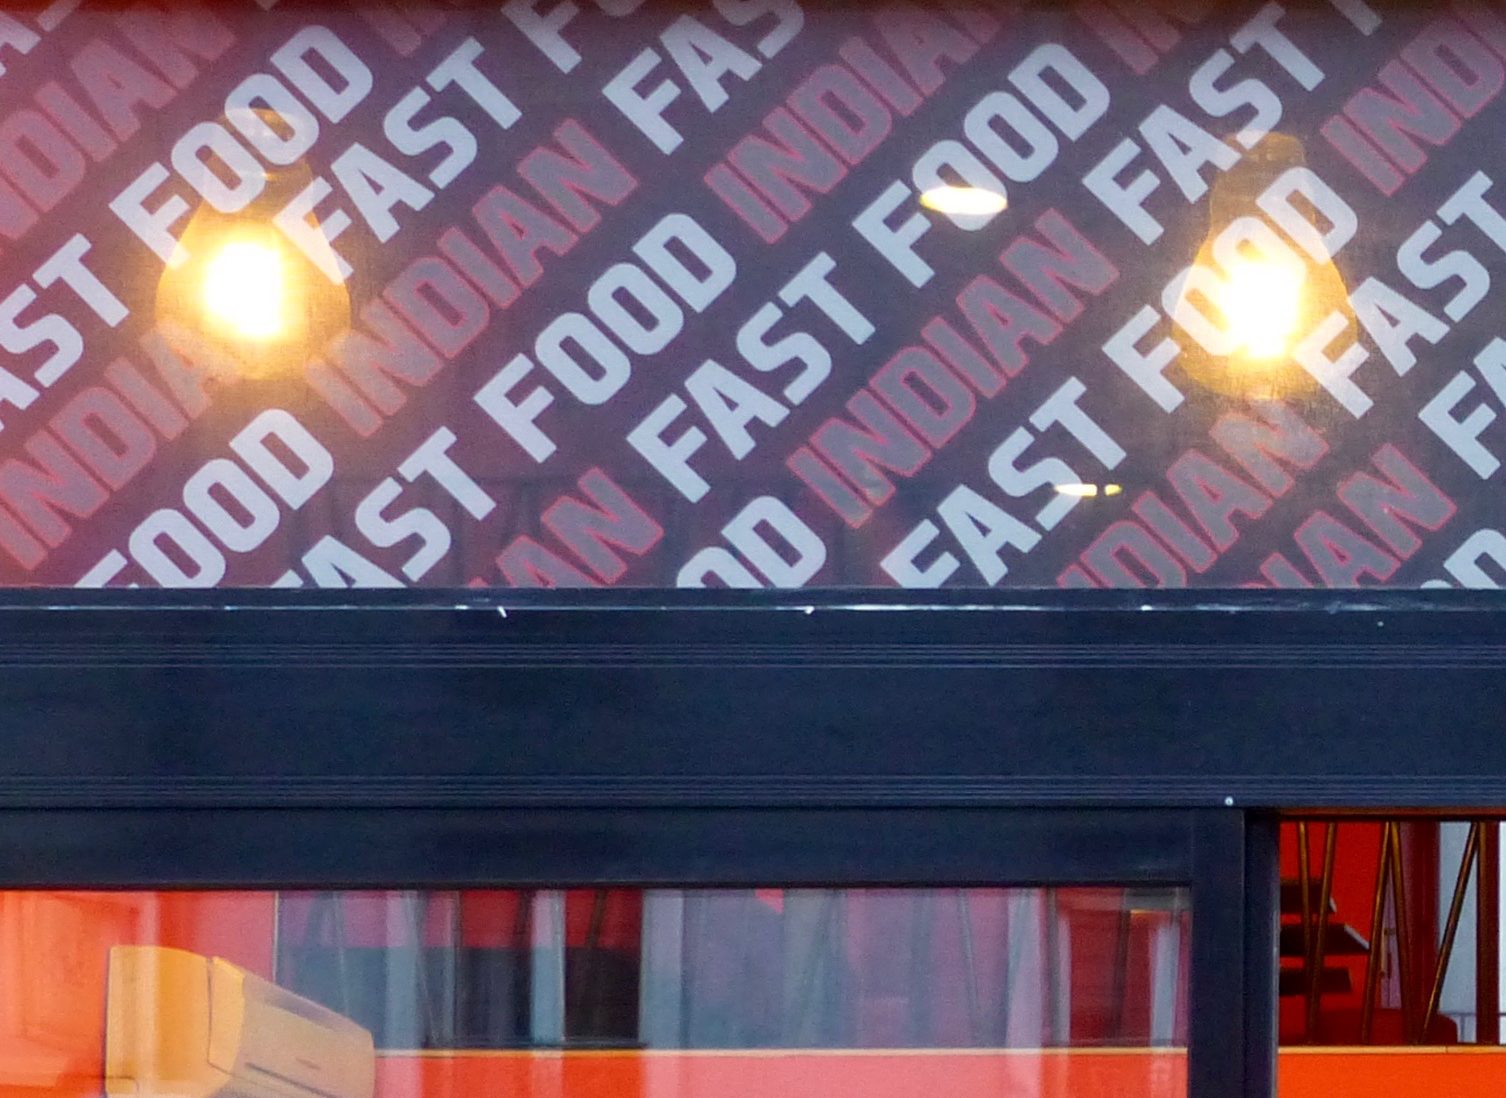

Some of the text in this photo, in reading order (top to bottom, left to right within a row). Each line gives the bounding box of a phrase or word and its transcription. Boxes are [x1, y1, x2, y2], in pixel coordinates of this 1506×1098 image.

[0, 36, 522, 571] INDIA FAST
[109, 24, 374, 271] FOOD
[300, 118, 638, 438] INDIAN
[602, 0, 806, 155] FAS
[626, 251, 876, 503] FAST
[851, 42, 1111, 289] FOOD
[786, 208, 1120, 528] INDIAN
[1081, 0, 1325, 245] FAST
[268, 427, 495, 588] AST
[473, 213, 736, 463] FOOD
[880, 377, 1126, 588] FAST
